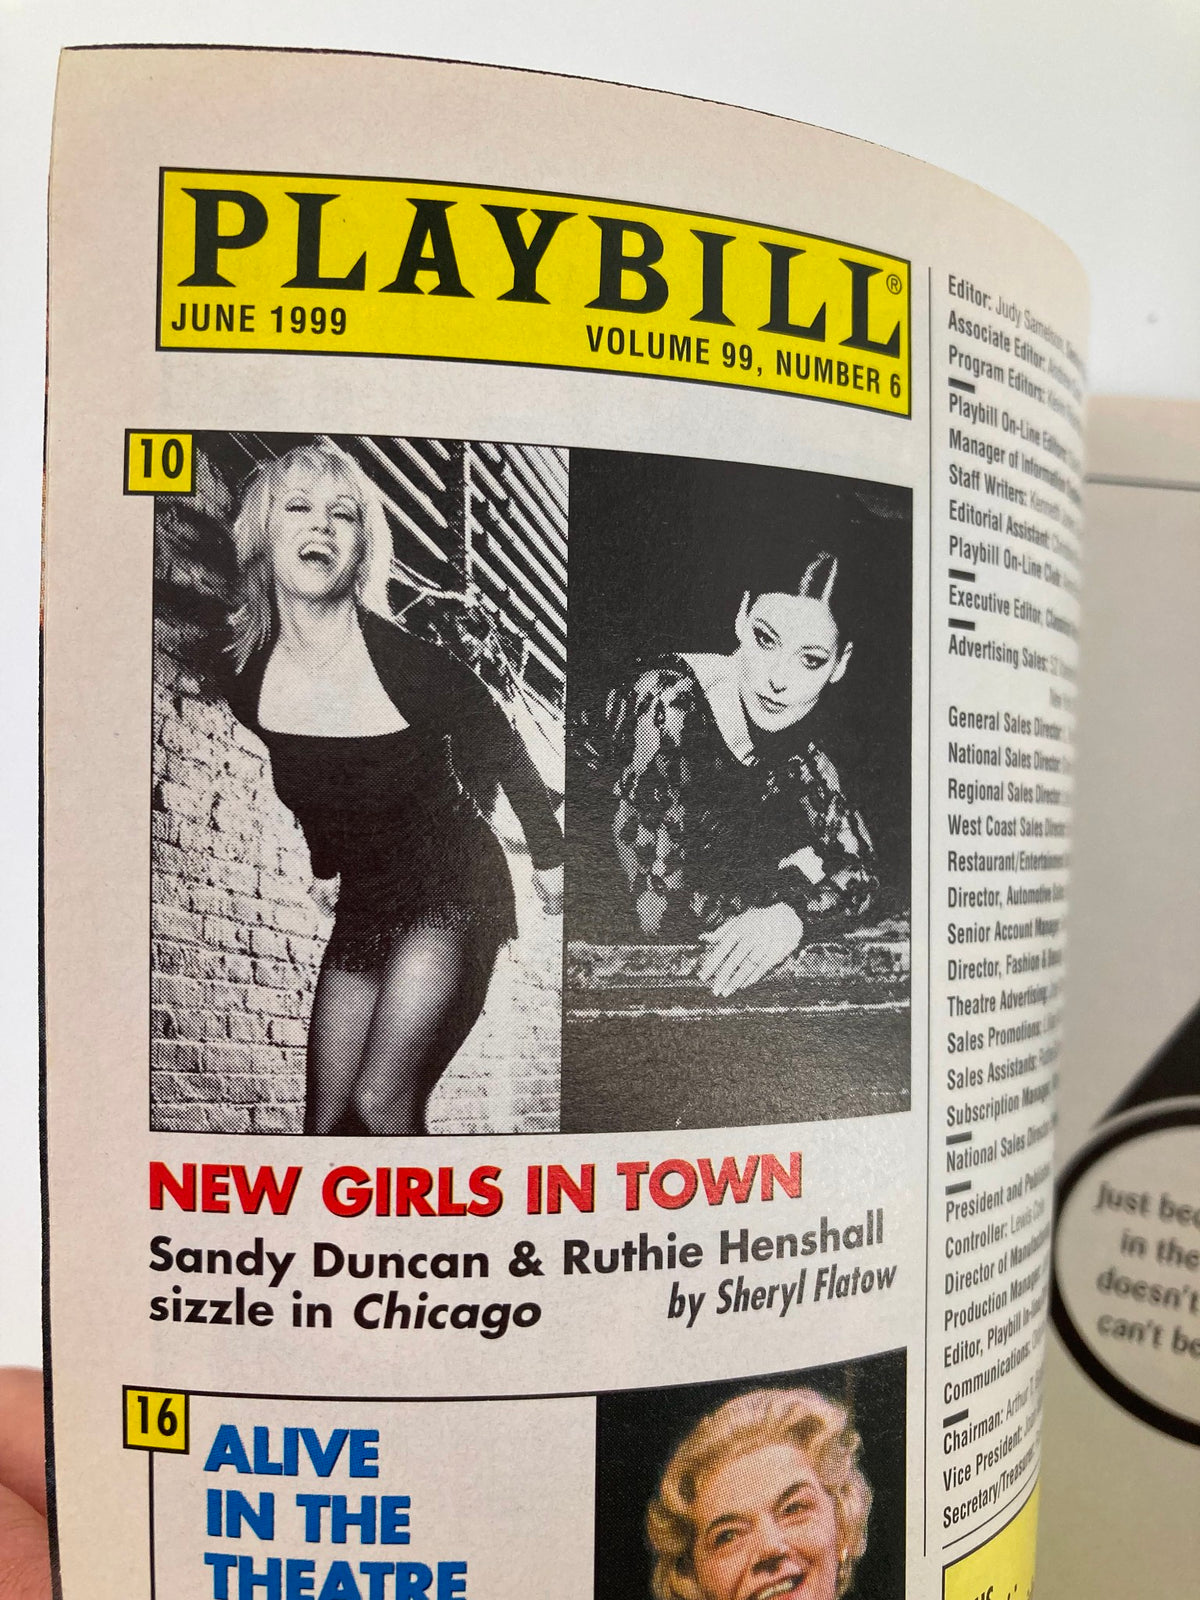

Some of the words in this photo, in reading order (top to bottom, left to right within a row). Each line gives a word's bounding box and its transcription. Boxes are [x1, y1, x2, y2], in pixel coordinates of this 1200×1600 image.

[171, 302, 256, 334] JUNE
[270, 305, 348, 336] 1999
[948, 274, 992, 310] Editor:
[996, 296, 1021, 328] Judy
[948, 310, 1010, 352] Associate
[586, 324, 710, 366] VOLUME
[721, 342, 763, 376] 99,
[776, 350, 881, 395] NUMBER
[890, 374, 902, 399] 6
[948, 344, 1004, 382] Program
[949, 393, 998, 427] Playbill
[1002, 411, 1040, 446] On-Line
[140, 438, 184, 479] 10
[949, 427, 1006, 465] Manager
[1008, 451, 1019, 469] of
[949, 463, 981, 491] Staff
[984, 475, 1027, 506] Writers:
[949, 499, 1002, 531] Editorial
[949, 535, 999, 571] Playbill
[1003, 549, 1041, 580] On-Line
[949, 584, 1010, 616] Executive
[949, 634, 1019, 669] Advertising
[949, 706, 1000, 731] General
[1004, 712, 1031, 735] Sales
[949, 742, 1001, 767] National
[1005, 747, 1031, 770] Sales
[948, 778, 1004, 804] Regional
[1008, 782, 1033, 803] Sales
[949, 814, 982, 836] West
[986, 814, 1017, 836] Coast
[1020, 817, 1043, 837] Sales
[948, 887, 1003, 909] Director,
[1007, 885, 1052, 905] Automotive
[948, 923, 990, 944] Senior
[994, 920, 1033, 942] Account
[948, 959, 1001, 981] Director,
[1006, 953, 1040, 975] Fashion
[948, 995, 996, 1017] Theatre
[948, 1031, 984, 1054] Sales
[947, 1069, 983, 1090] Sales
[947, 1093, 1019, 1128] Subscription
[947, 1139, 997, 1173] National
[1001, 1132, 1025, 1158] Sales
[149, 1161, 302, 1216] NEW
[322, 1165, 504, 1218] GIRLS
[527, 1162, 595, 1215] IN
[616, 1151, 803, 1213] TOWN
[946, 1187, 1004, 1223] President
[1006, 1178, 1023, 1204] and
[149, 1235, 295, 1287] Sandy
[314, 1240, 490, 1280] Duncan
[508, 1241, 543, 1277] &
[563, 1230, 704, 1276] Ruthie
[719, 1209, 885, 1265] Henshall
[945, 1226, 1008, 1259] Controller:
[1120, 1228, 1147, 1257] in
[945, 1263, 994, 1295] Director
[998, 1252, 1008, 1273] of
[149, 1287, 274, 1328] sizzle
[292, 1295, 333, 1329] in
[352, 1291, 543, 1341] Chicago
[667, 1280, 704, 1328] by
[714, 1267, 807, 1319] Sheryl
[813, 1263, 898, 1304] Flatow
[945, 1290, 1007, 1331] Production
[944, 1340, 983, 1370] Editor,
[988, 1311, 1021, 1349] Playbill
[1098, 1313, 1163, 1348] can't
[944, 1340, 1031, 1404] Communications:
[135, 1396, 179, 1438] 16
[944, 1409, 1003, 1455] Chairman:
[204, 1425, 380, 1479] ALIVE
[943, 1465, 971, 1491] Vice
[976, 1426, 1022, 1476] President:
[206, 1488, 275, 1542] IN
[295, 1494, 412, 1546] THE
[204, 1552, 469, 1600] THEATRE
